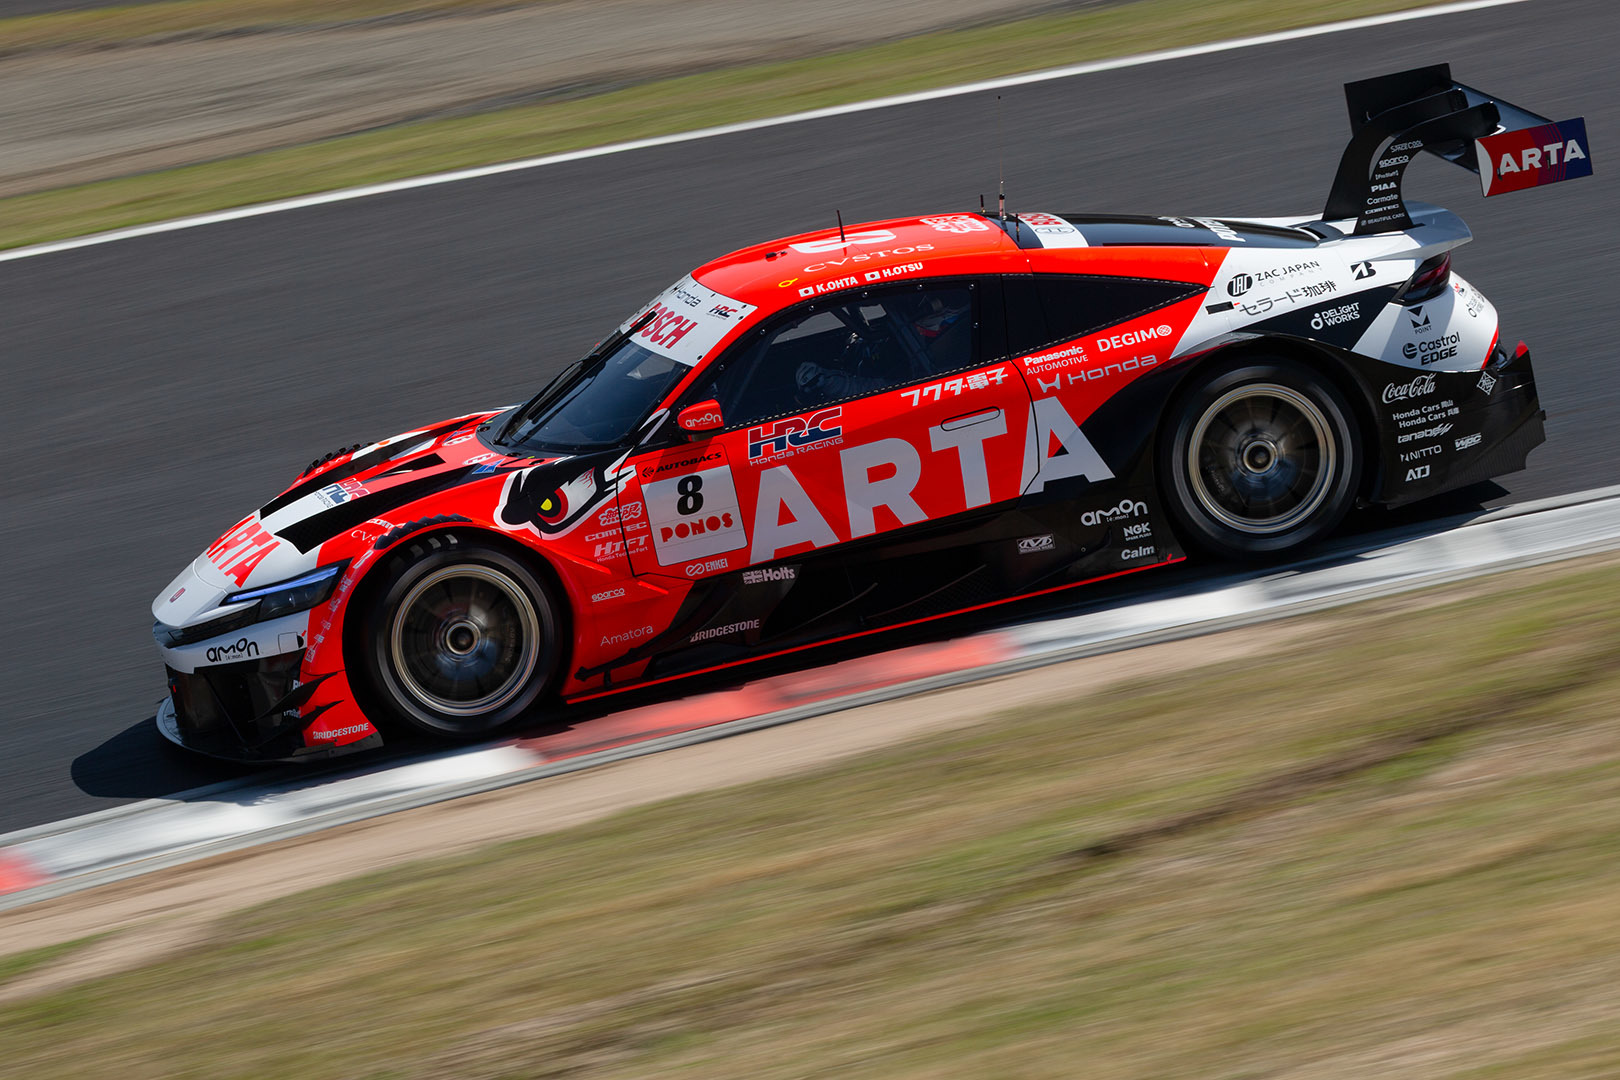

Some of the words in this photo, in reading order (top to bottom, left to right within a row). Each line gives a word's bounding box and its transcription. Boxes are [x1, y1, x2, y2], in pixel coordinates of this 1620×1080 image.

[1500, 139, 1586, 175] ARTA
[1371, 181, 1397, 192] PIAA
[1366, 194, 1398, 205] Carmate
[803, 243, 935, 273] CVSTOS
[882, 262, 924, 278] H.OTSU
[1255, 268, 1280, 282] ZAC
[1283, 260, 1320, 275] JAPAN
[816, 276, 858, 294] K.OHTA
[1239, 279, 1337, 316] セラード珈琲
[1325, 311, 1361, 327] WORKS
[1414, 325, 1432, 335] POINT
[1418, 331, 1460, 352] Castrol
[1024, 346, 1084, 366] Panasonic
[1026, 354, 1089, 376] AUTOMOTIVE
[1421, 345, 1457, 366] EDGE
[1068, 354, 1158, 385] Honda
[685, 413, 721, 428] amon
[1392, 408, 1420, 421] Honda
[1421, 404, 1440, 414] Cars
[1399, 415, 1427, 428] Honda
[1427, 411, 1446, 422] Cars
[748, 406, 842, 460] HRC
[656, 451, 722, 474] AUTOBACS
[750, 451, 795, 467] Honda
[796, 437, 844, 455] RACING
[1410, 444, 1443, 461] NITTO
[749, 395, 1116, 565] ARTA
[676, 475, 704, 516] 8
[1081, 499, 1148, 527] amon
[660, 512, 733, 543] PONOS
[1123, 522, 1151, 538] NGK
[206, 515, 281, 589] ARTA
[1121, 545, 1155, 560] Calm
[705, 558, 728, 573] ENKEI
[763, 566, 796, 581] Holts
[592, 588, 625, 602] sparco
[600, 624, 654, 647] Amatora
[689, 619, 760, 643] BRIDGESTONE
[206, 638, 260, 663] amon
[312, 722, 369, 740] BRIDGESTONE
